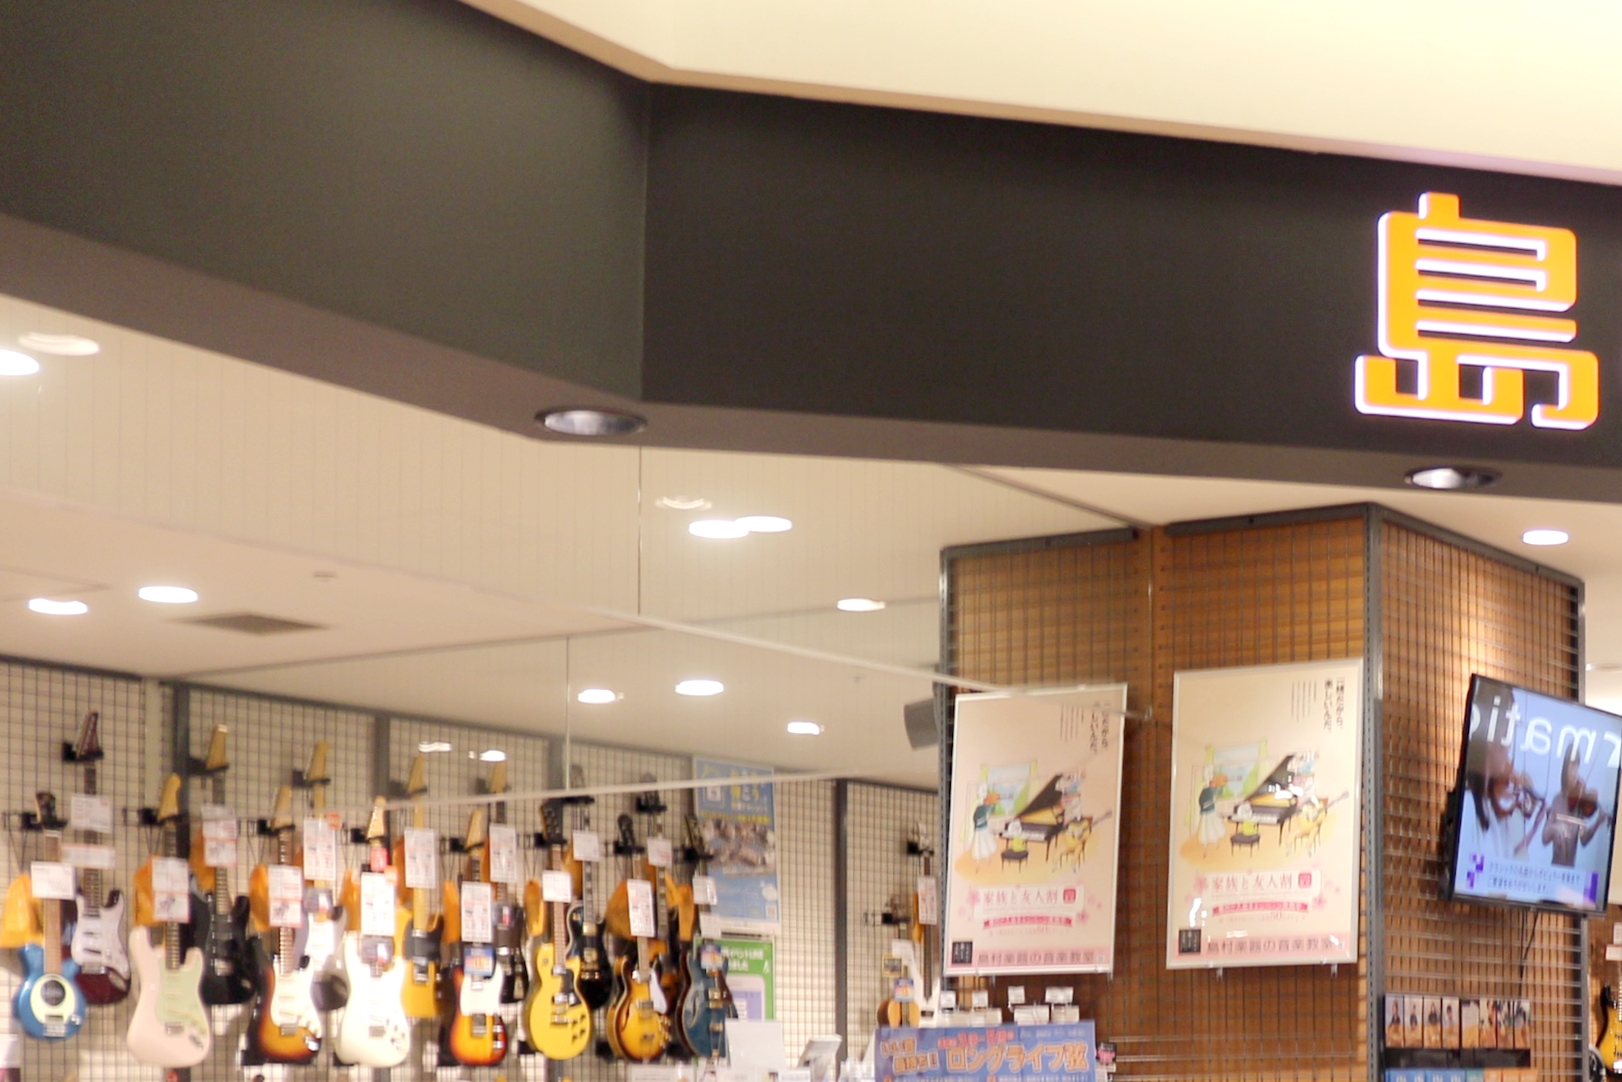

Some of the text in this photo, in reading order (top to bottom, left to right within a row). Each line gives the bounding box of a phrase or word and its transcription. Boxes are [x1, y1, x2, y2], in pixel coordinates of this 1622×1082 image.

[1207, 936, 1333, 955] 島村楽器の音楽教室
[977, 950, 1095, 966] 島村楽器の音楽教室
[946, 1042, 1088, 1073] ロングライフ弦
